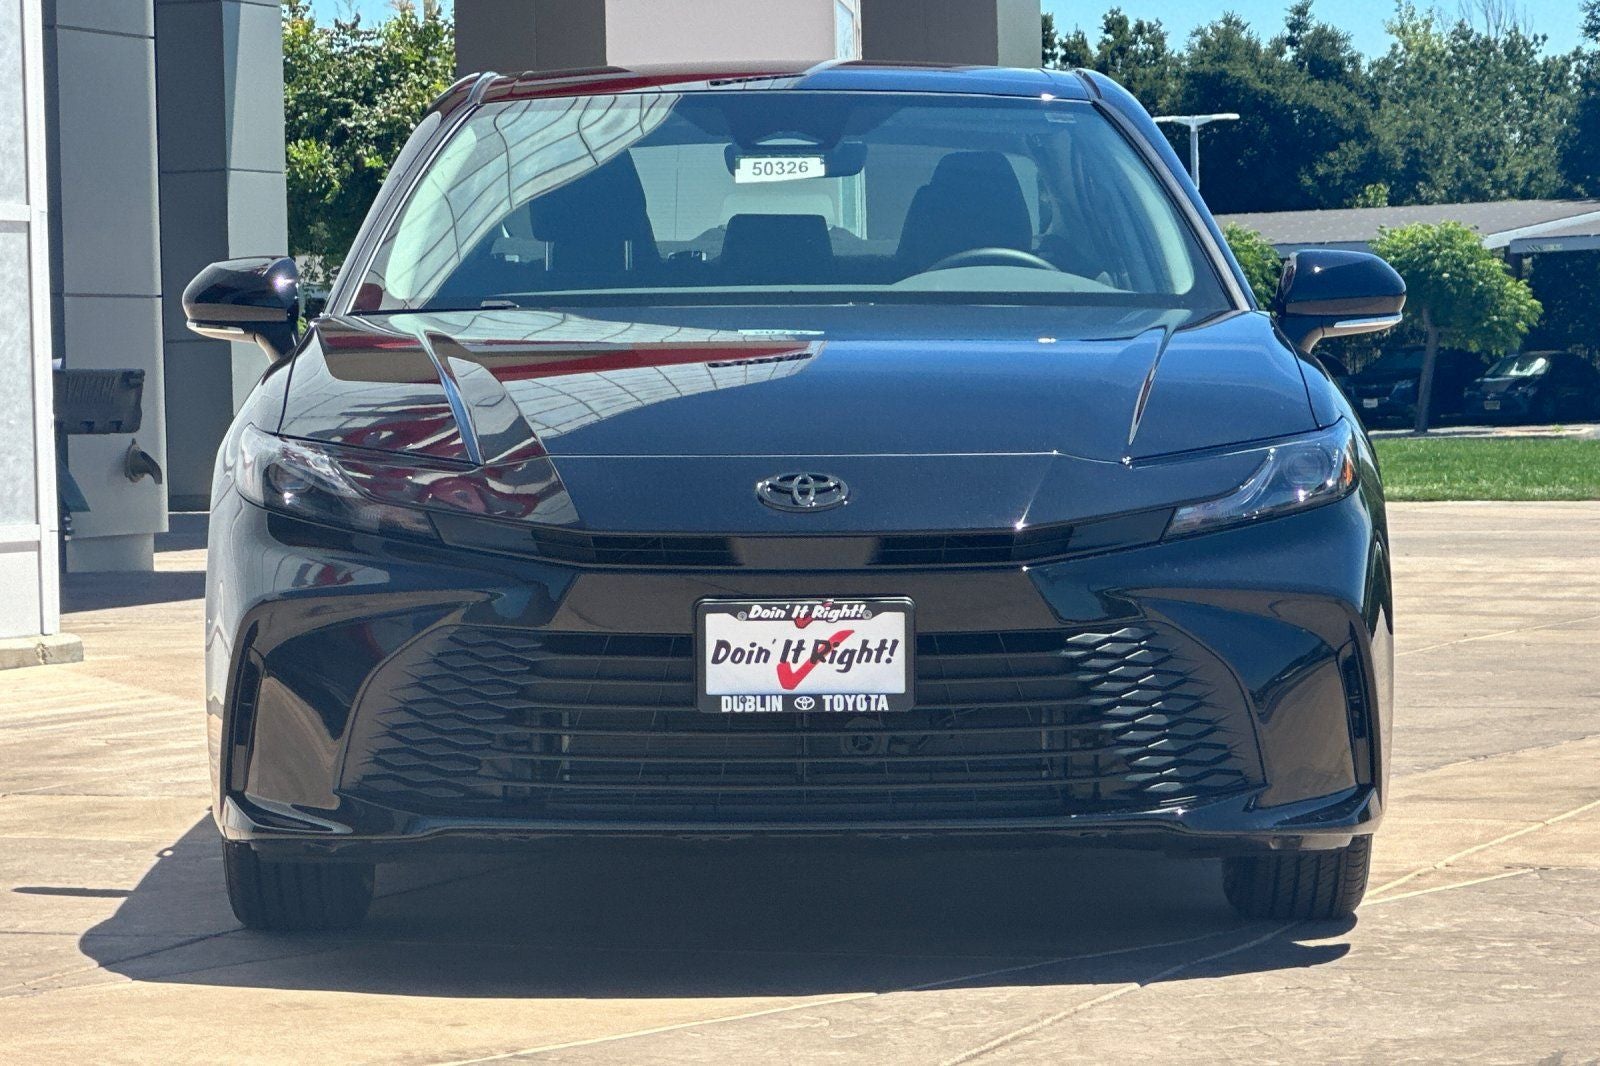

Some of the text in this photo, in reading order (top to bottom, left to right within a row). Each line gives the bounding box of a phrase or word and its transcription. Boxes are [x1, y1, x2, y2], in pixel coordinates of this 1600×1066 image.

[752, 161, 809, 176] 50326
[748, 604, 866, 622] Doin' It Right!
[711, 638, 899, 674] Doin' It Right!
[721, 694, 889, 713] DUBLIN TOYOTA
